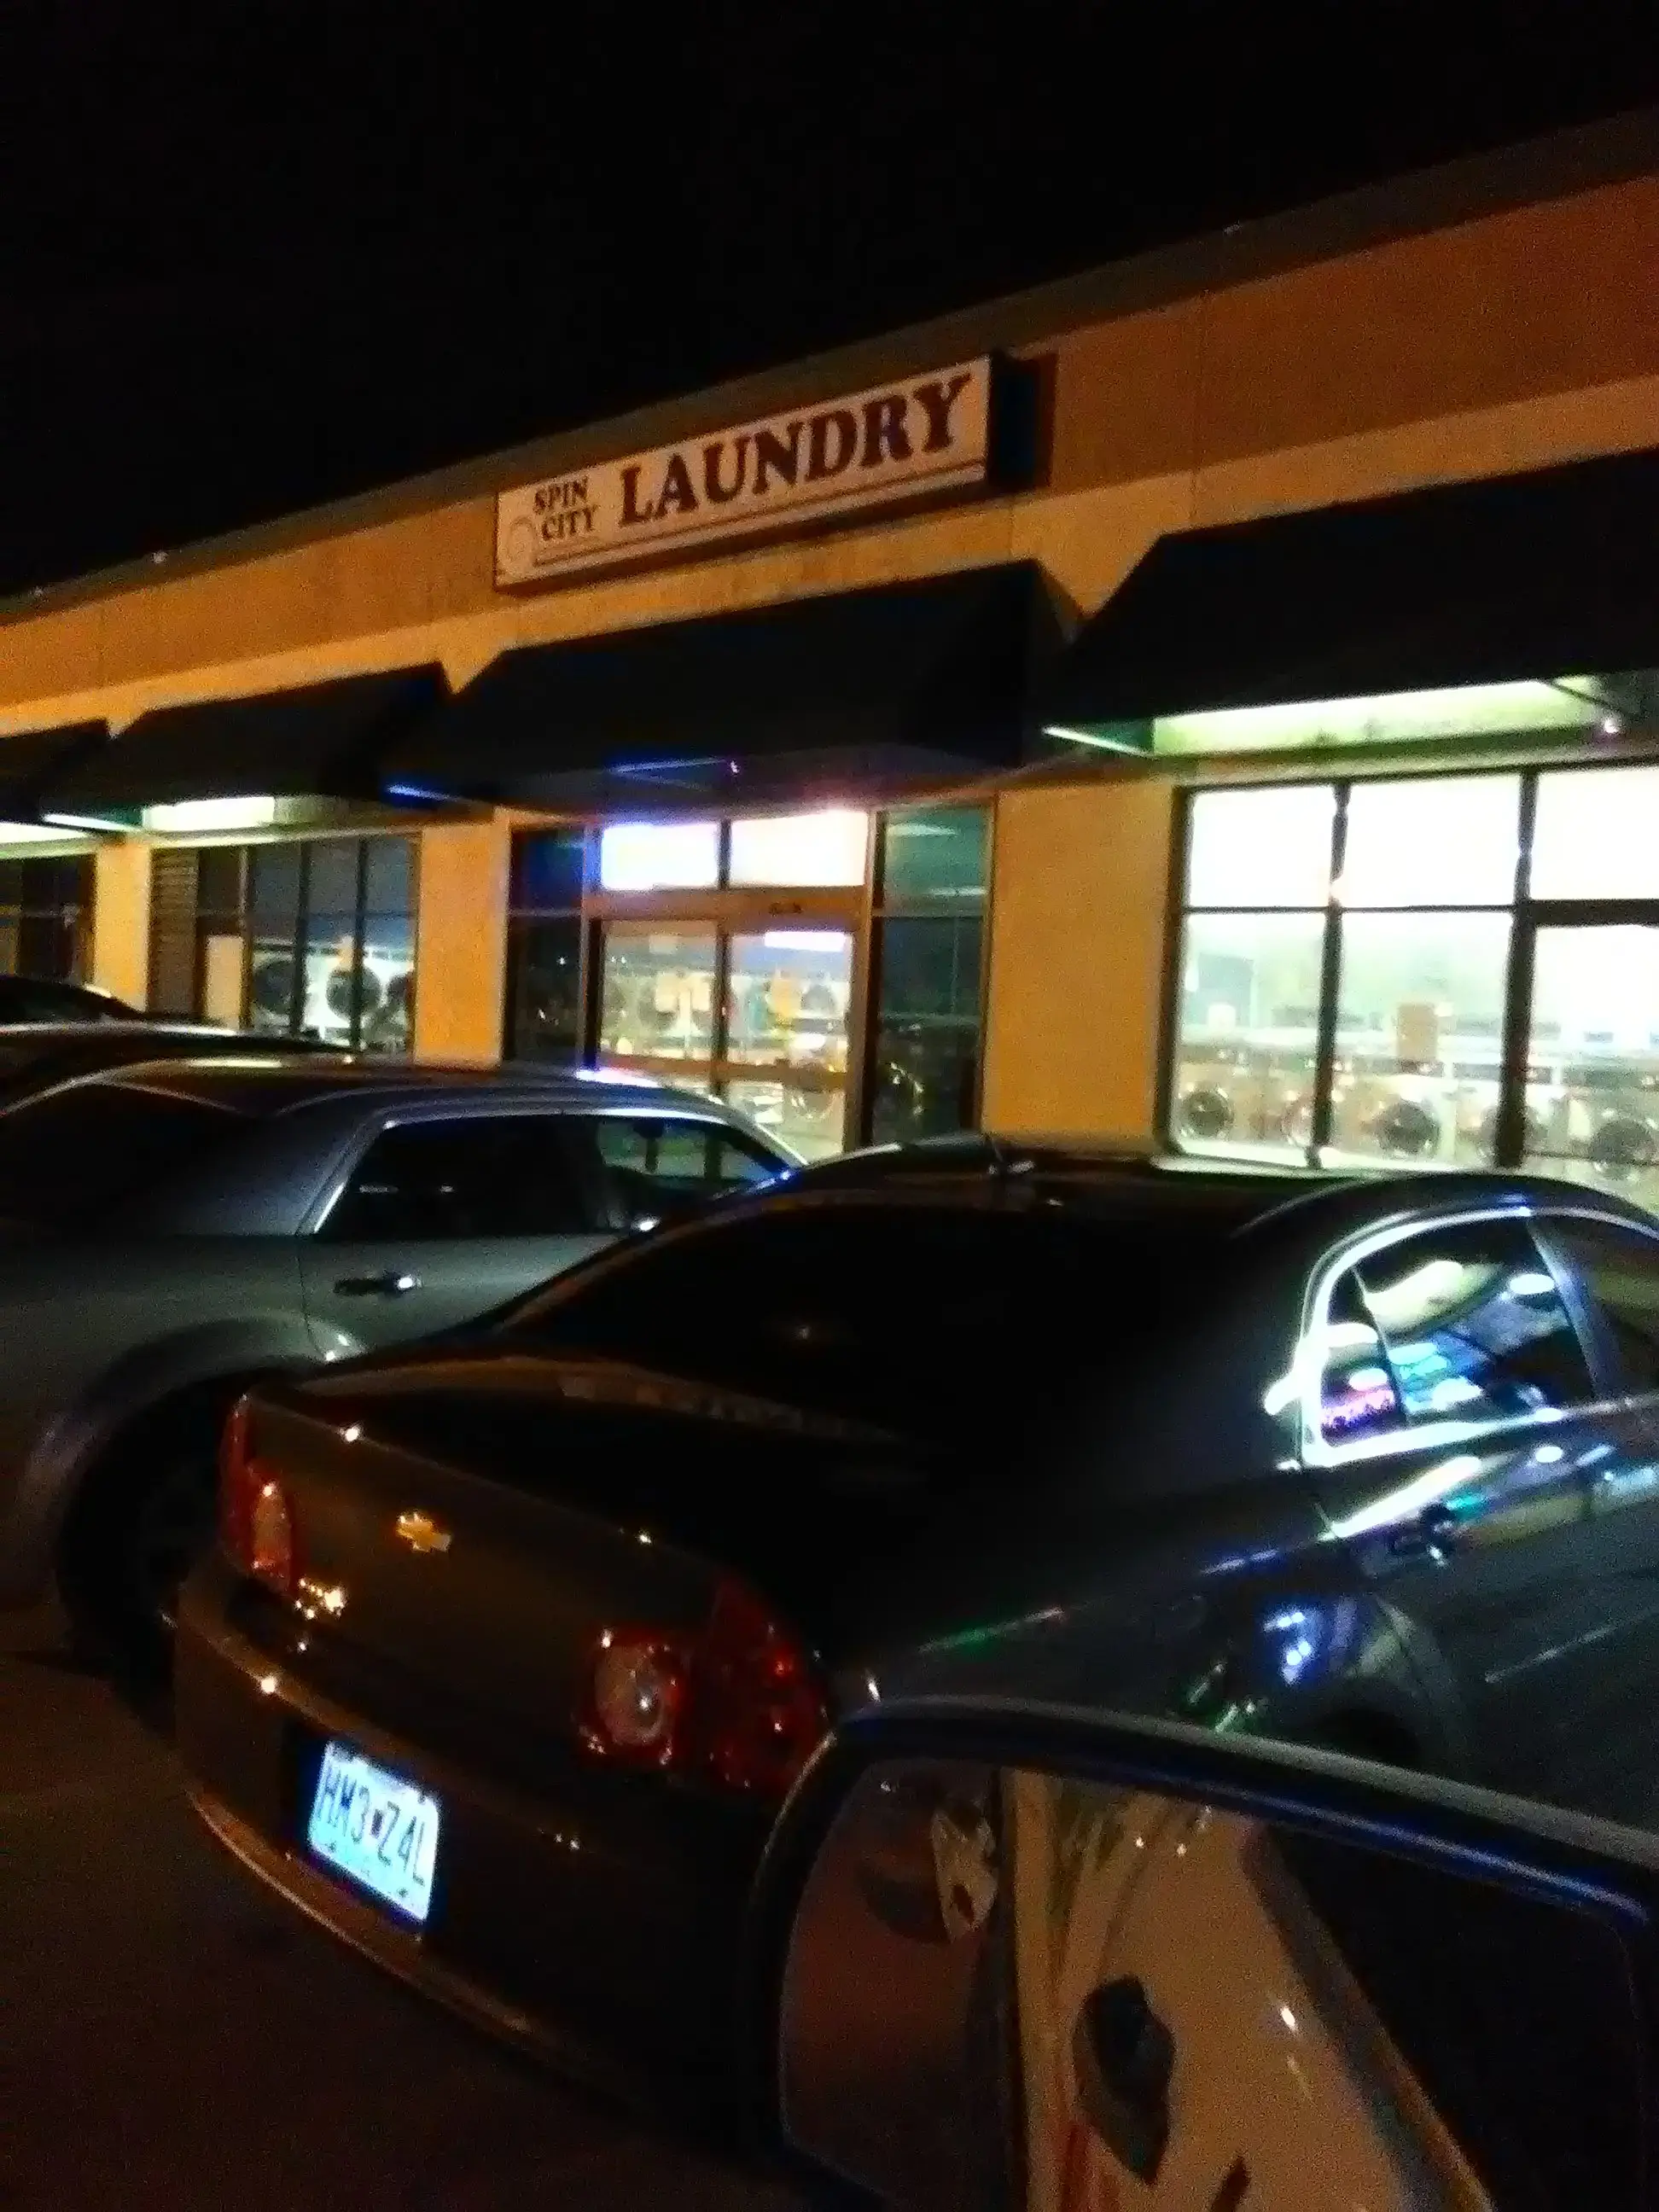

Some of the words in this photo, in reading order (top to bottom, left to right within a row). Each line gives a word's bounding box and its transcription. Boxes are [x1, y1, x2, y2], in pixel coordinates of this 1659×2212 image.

[618, 374, 971, 527] LAUNDRY
[533, 476, 590, 515] SPIN
[541, 504, 599, 541] CITY
